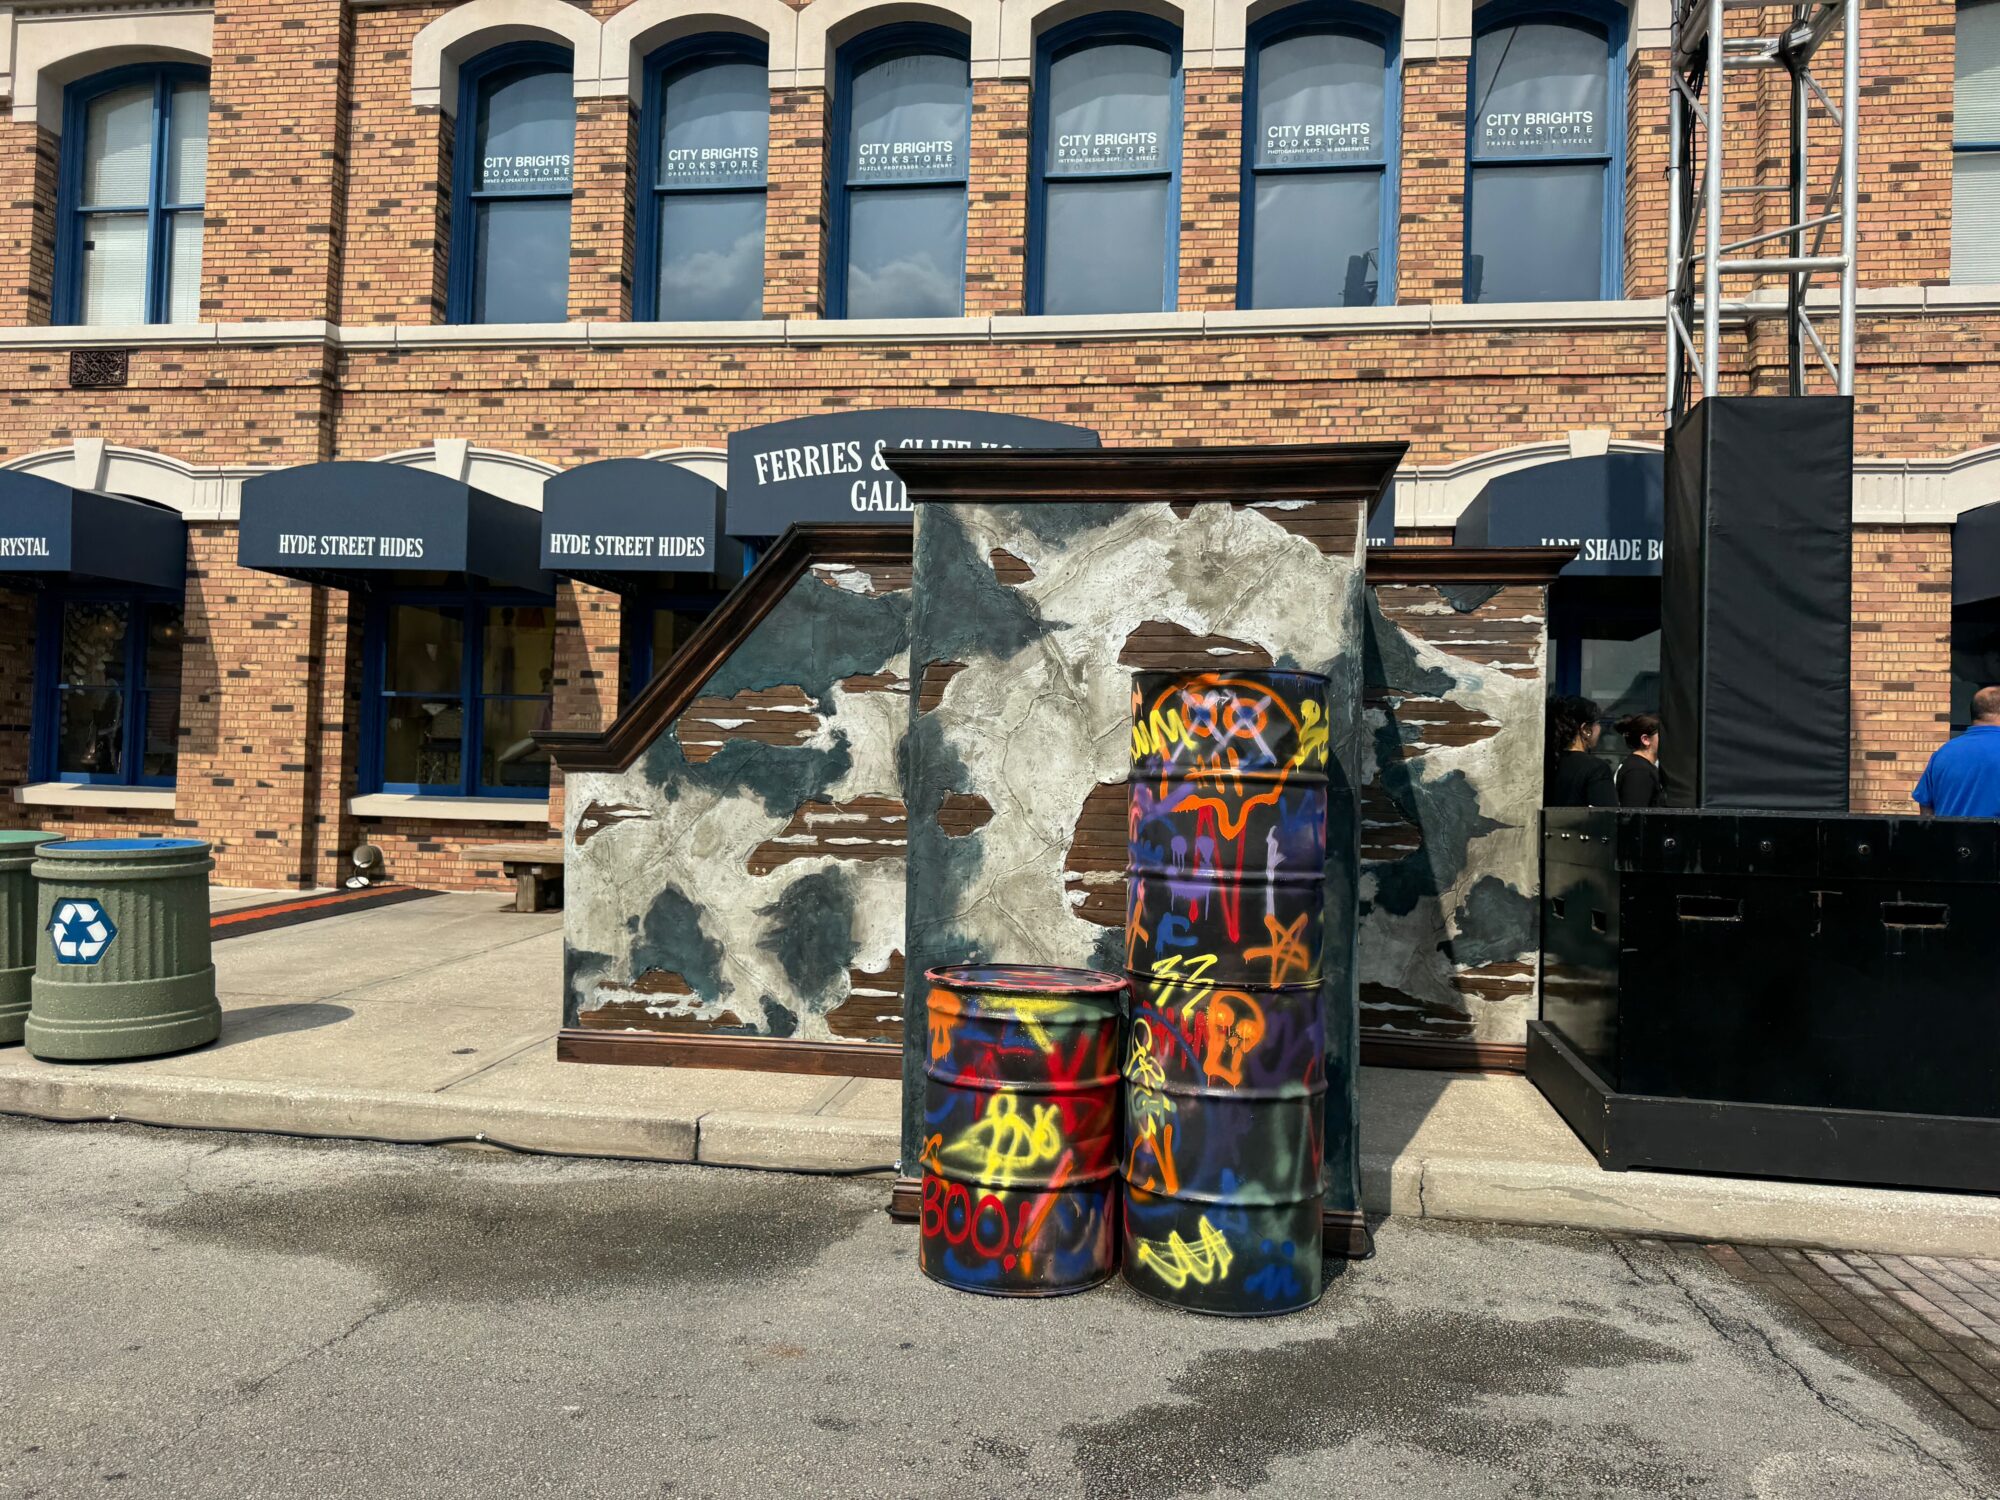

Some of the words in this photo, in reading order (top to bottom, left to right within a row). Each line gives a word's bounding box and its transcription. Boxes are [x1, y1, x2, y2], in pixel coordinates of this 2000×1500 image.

[1487, 114, 1521, 126] CITY
[1526, 111, 1593, 124] BRIGHTS
[1268, 126, 1302, 138] CITY
[1305, 123, 1370, 137] BRIGHTS
[1486, 125, 1592, 136] BOOKSTORE
[1059, 134, 1091, 147] CITY
[1095, 132, 1157, 145] BRIGHTS
[1267, 137, 1370, 148] BOOKSTORE
[668, 149, 698, 161] CITY
[701, 147, 759, 160] BRIGHTS
[860, 143, 890, 155] CITY
[894, 141, 953, 154] BRIGHTS
[1058, 145, 1157, 157] BOOKSTORE
[484, 156, 512, 168] CITY
[515, 155, 570, 167] BRIGHTS
[668, 160, 758, 170] BOOKSTORE
[859, 154, 953, 165] BOOKSTORE
[484, 168, 570, 177] BOOKSTORE
[753, 441, 863, 485] FERRIES
[870, 439, 890, 471] &
[0, 537, 50, 556] RYSTAL
[279, 534, 317, 555] HYDE
[320, 535, 376, 556] STREET
[379, 537, 424, 558] HIDES
[550, 533, 591, 555] HYDE
[595, 535, 654, 556] STREET
[658, 536, 705, 557] HIDES
[1585, 538, 1642, 561] SHADE
[1647, 539, 1664, 560] B
[923, 1174, 1032, 1272] BOO!
